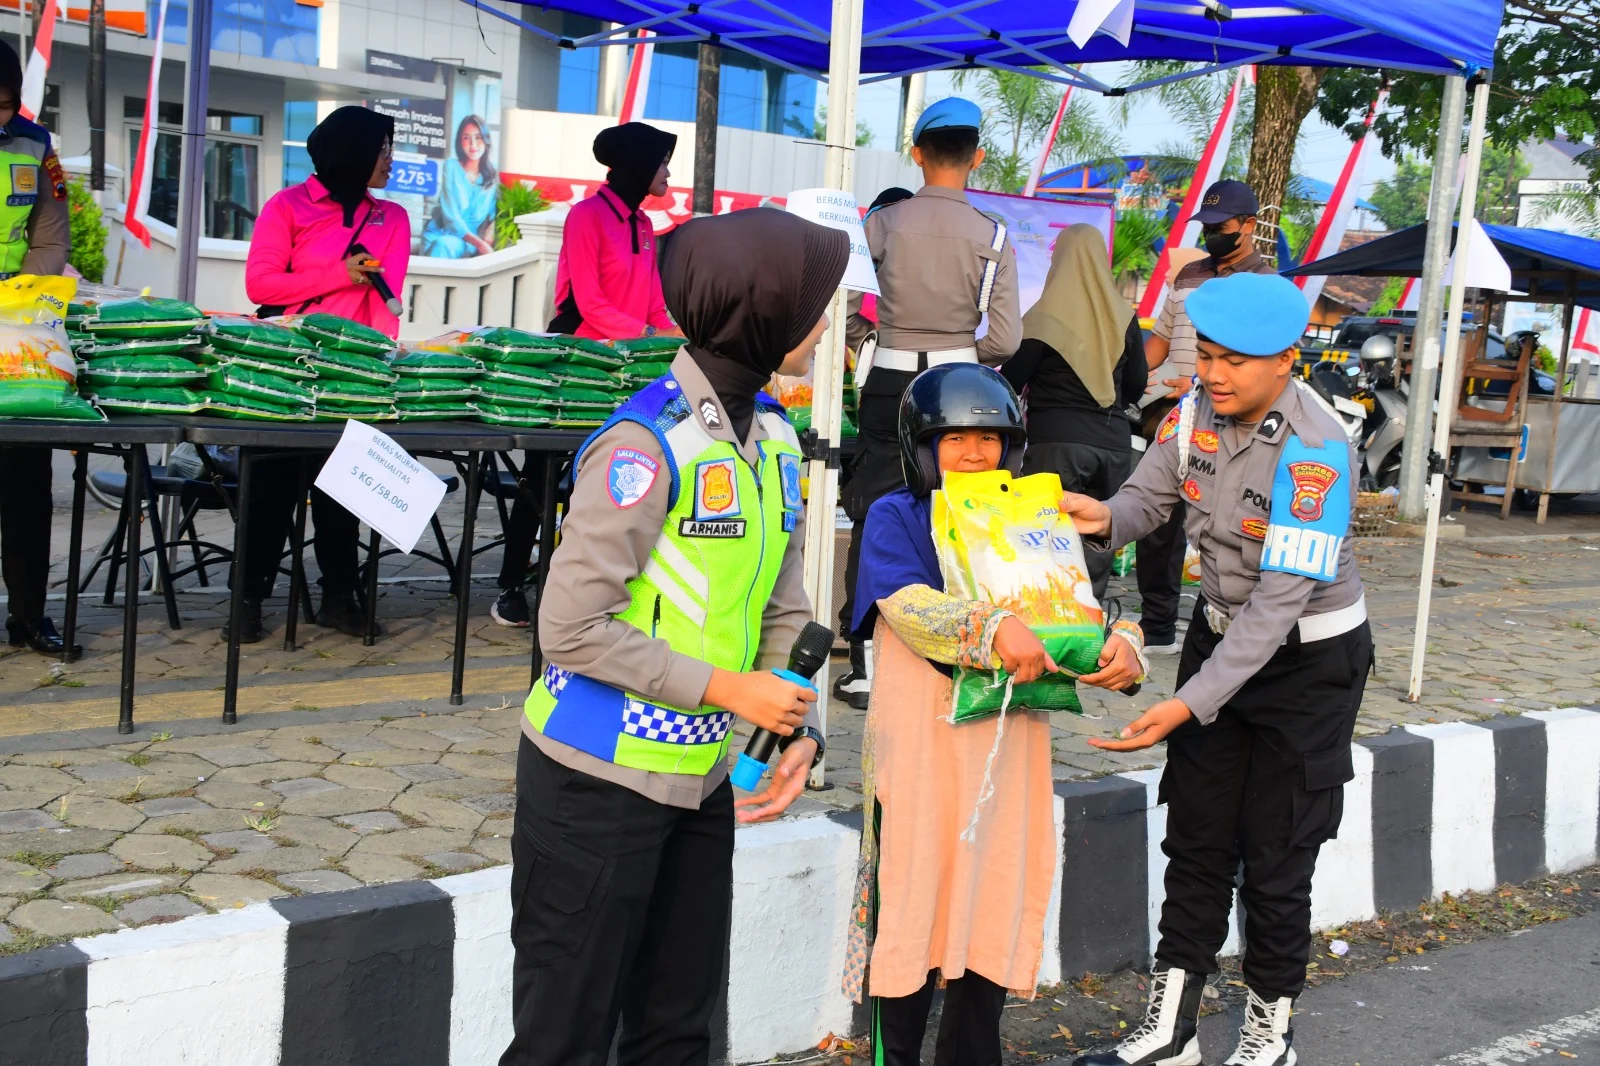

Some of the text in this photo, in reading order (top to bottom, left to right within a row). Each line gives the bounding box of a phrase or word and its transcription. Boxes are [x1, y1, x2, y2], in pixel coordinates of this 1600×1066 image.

[374, 104, 444, 125] Rumah Impian
[412, 123, 444, 136] Promo
[409, 134, 429, 147] KPR
[430, 137, 446, 149] BRI
[816, 196, 842, 207] BERAS
[818, 211, 862, 226] BERKUALITA
[372, 435, 420, 475] BERAS MURAH
[367, 448, 411, 485] BERKUALITAS
[1188, 453, 1216, 476] UKMA
[1294, 464, 1333, 478] POLRES
[350, 465, 409, 513] 5 KG /58.000
[689, 522, 739, 535] ARHANIS
